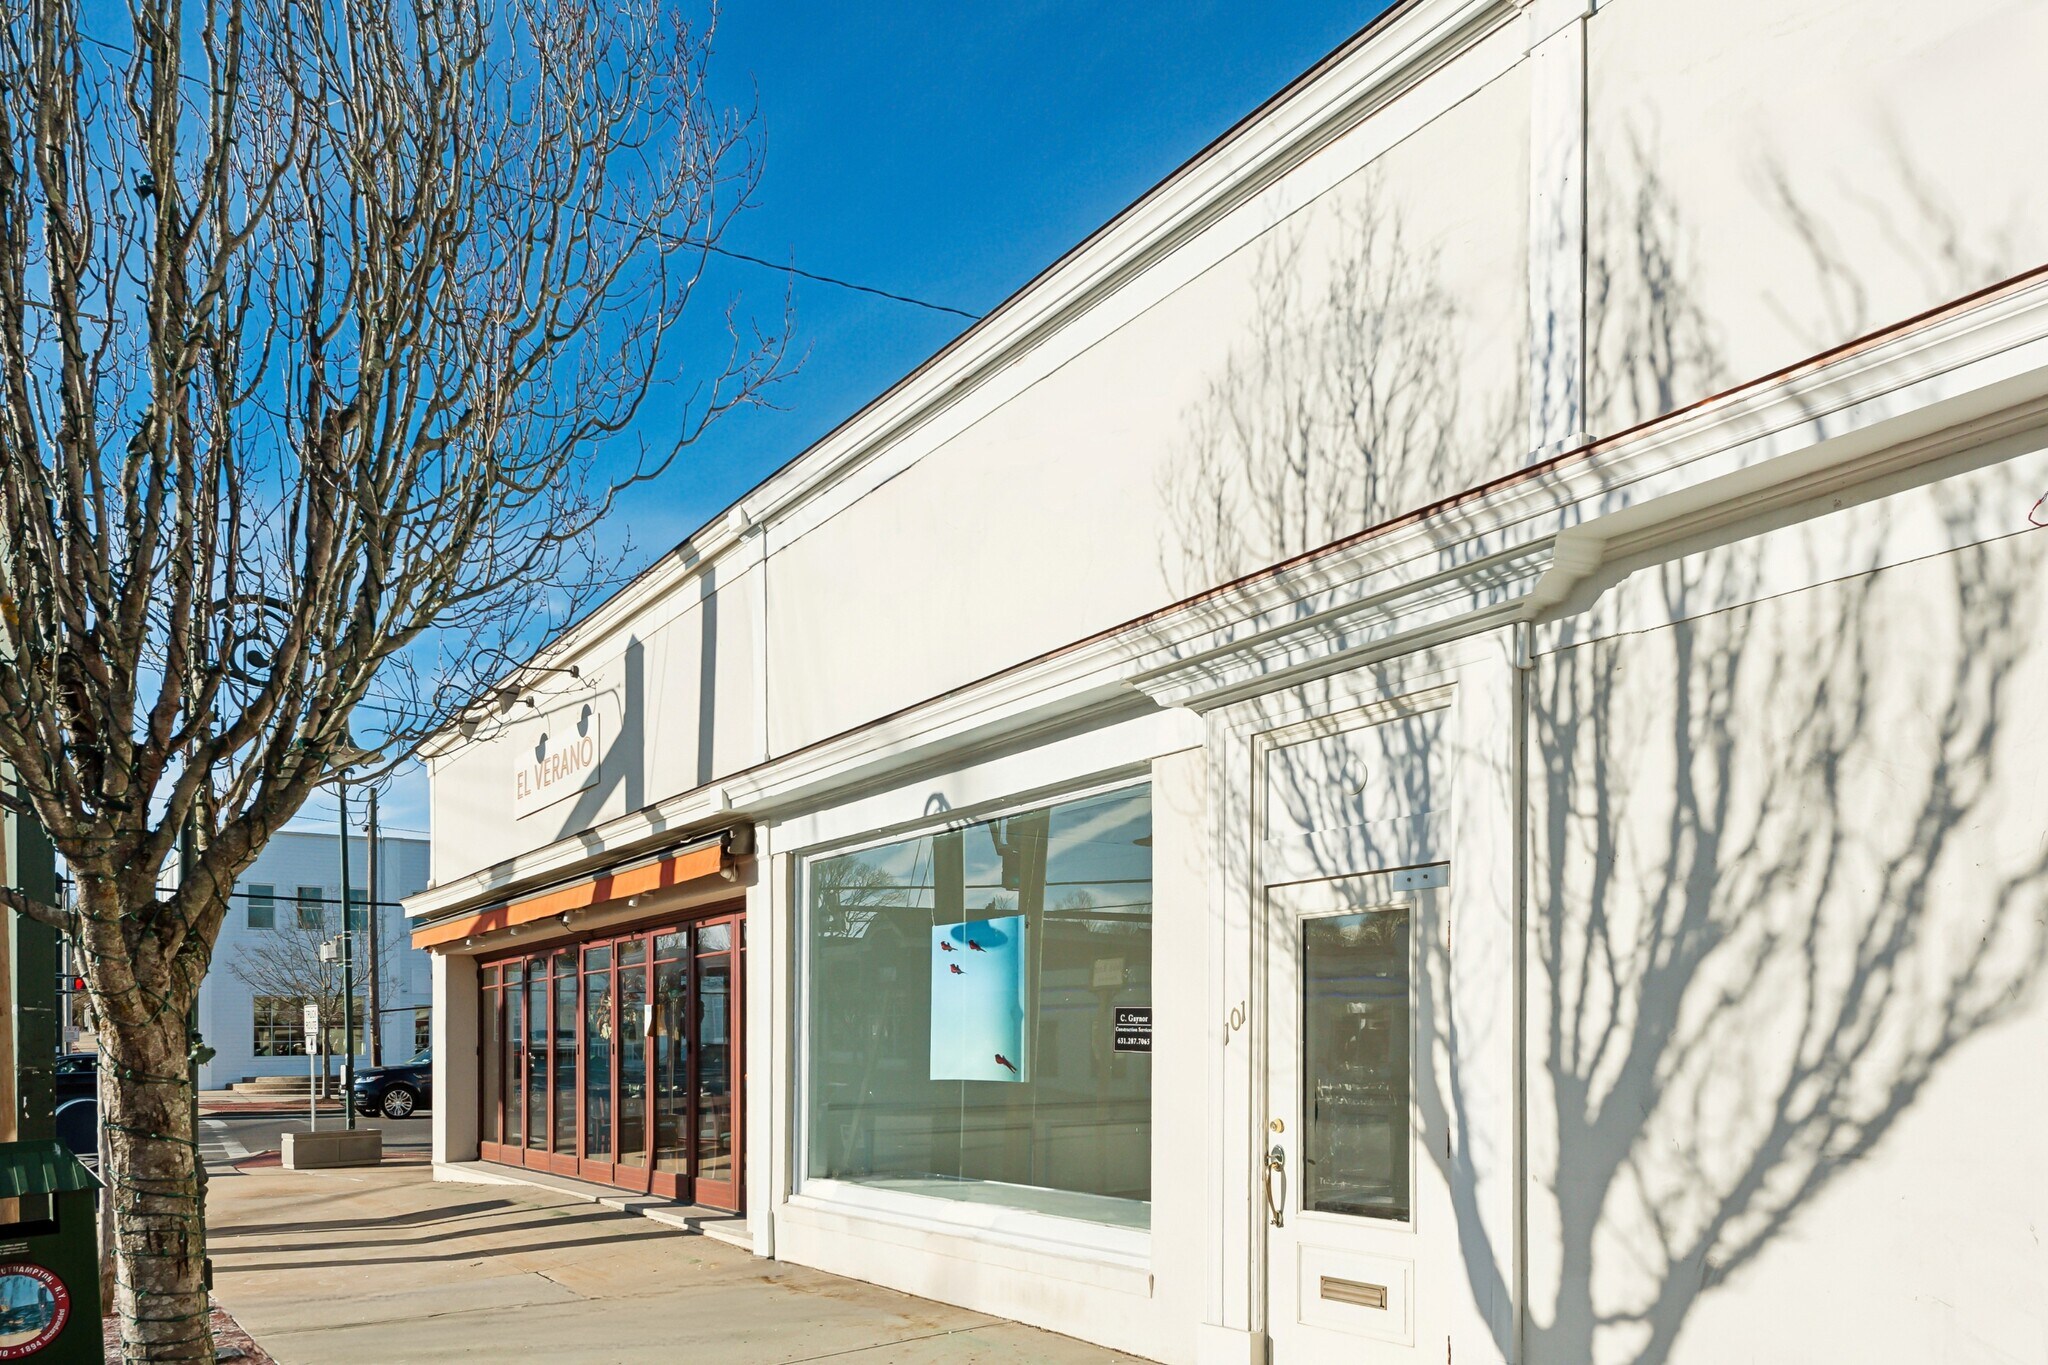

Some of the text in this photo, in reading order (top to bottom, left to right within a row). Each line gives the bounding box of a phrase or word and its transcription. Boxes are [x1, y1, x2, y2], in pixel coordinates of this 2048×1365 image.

[517, 736, 593, 800] EL VERANO
[1120, 1014, 1148, 1024] C. Gaynor
[1224, 1000, 1246, 1046] 101
[20, 1340, 42, 1354] 1894
[42, 1308, 66, 1342] Incorporated
